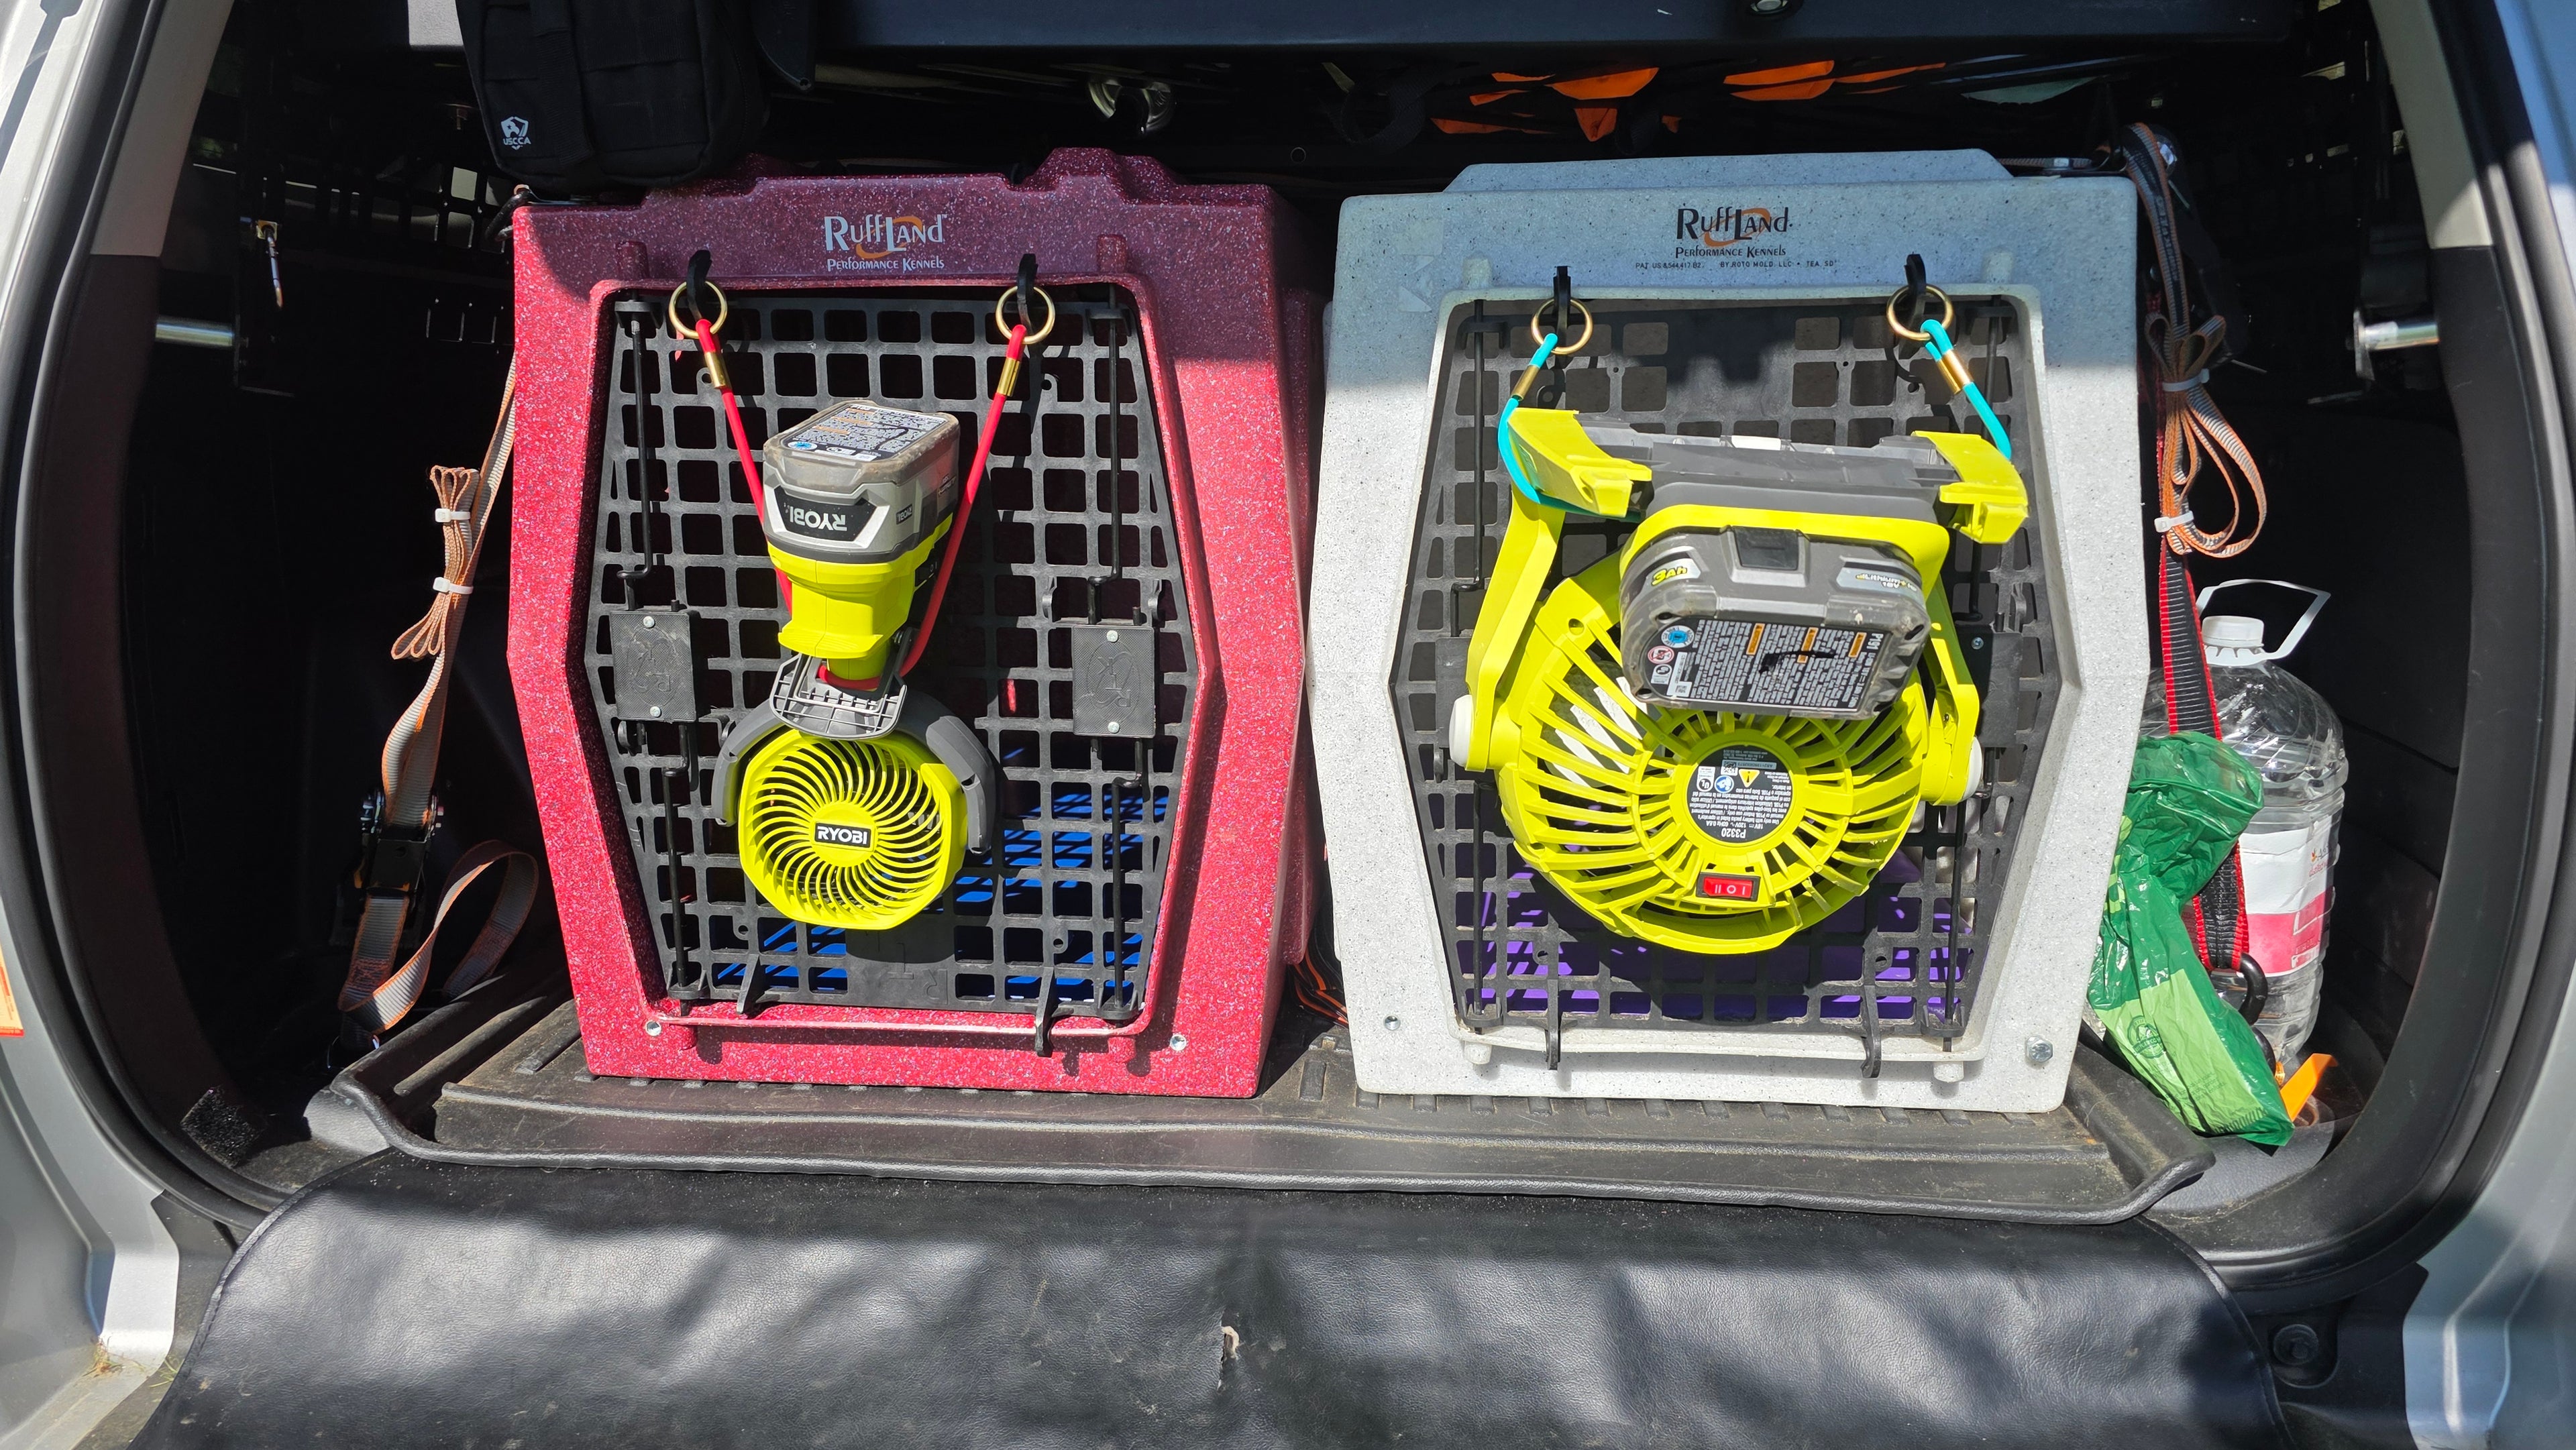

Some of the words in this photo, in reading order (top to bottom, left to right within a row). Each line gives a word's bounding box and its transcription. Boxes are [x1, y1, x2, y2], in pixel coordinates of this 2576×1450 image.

[503, 137, 531, 145] USCCA
[790, 506, 847, 531] RYOBI
[1652, 566, 1688, 586] 3Ah
[1866, 632, 1884, 650] P191
[817, 826, 867, 844] RYOBI
[1721, 828, 1746, 838] P3320
